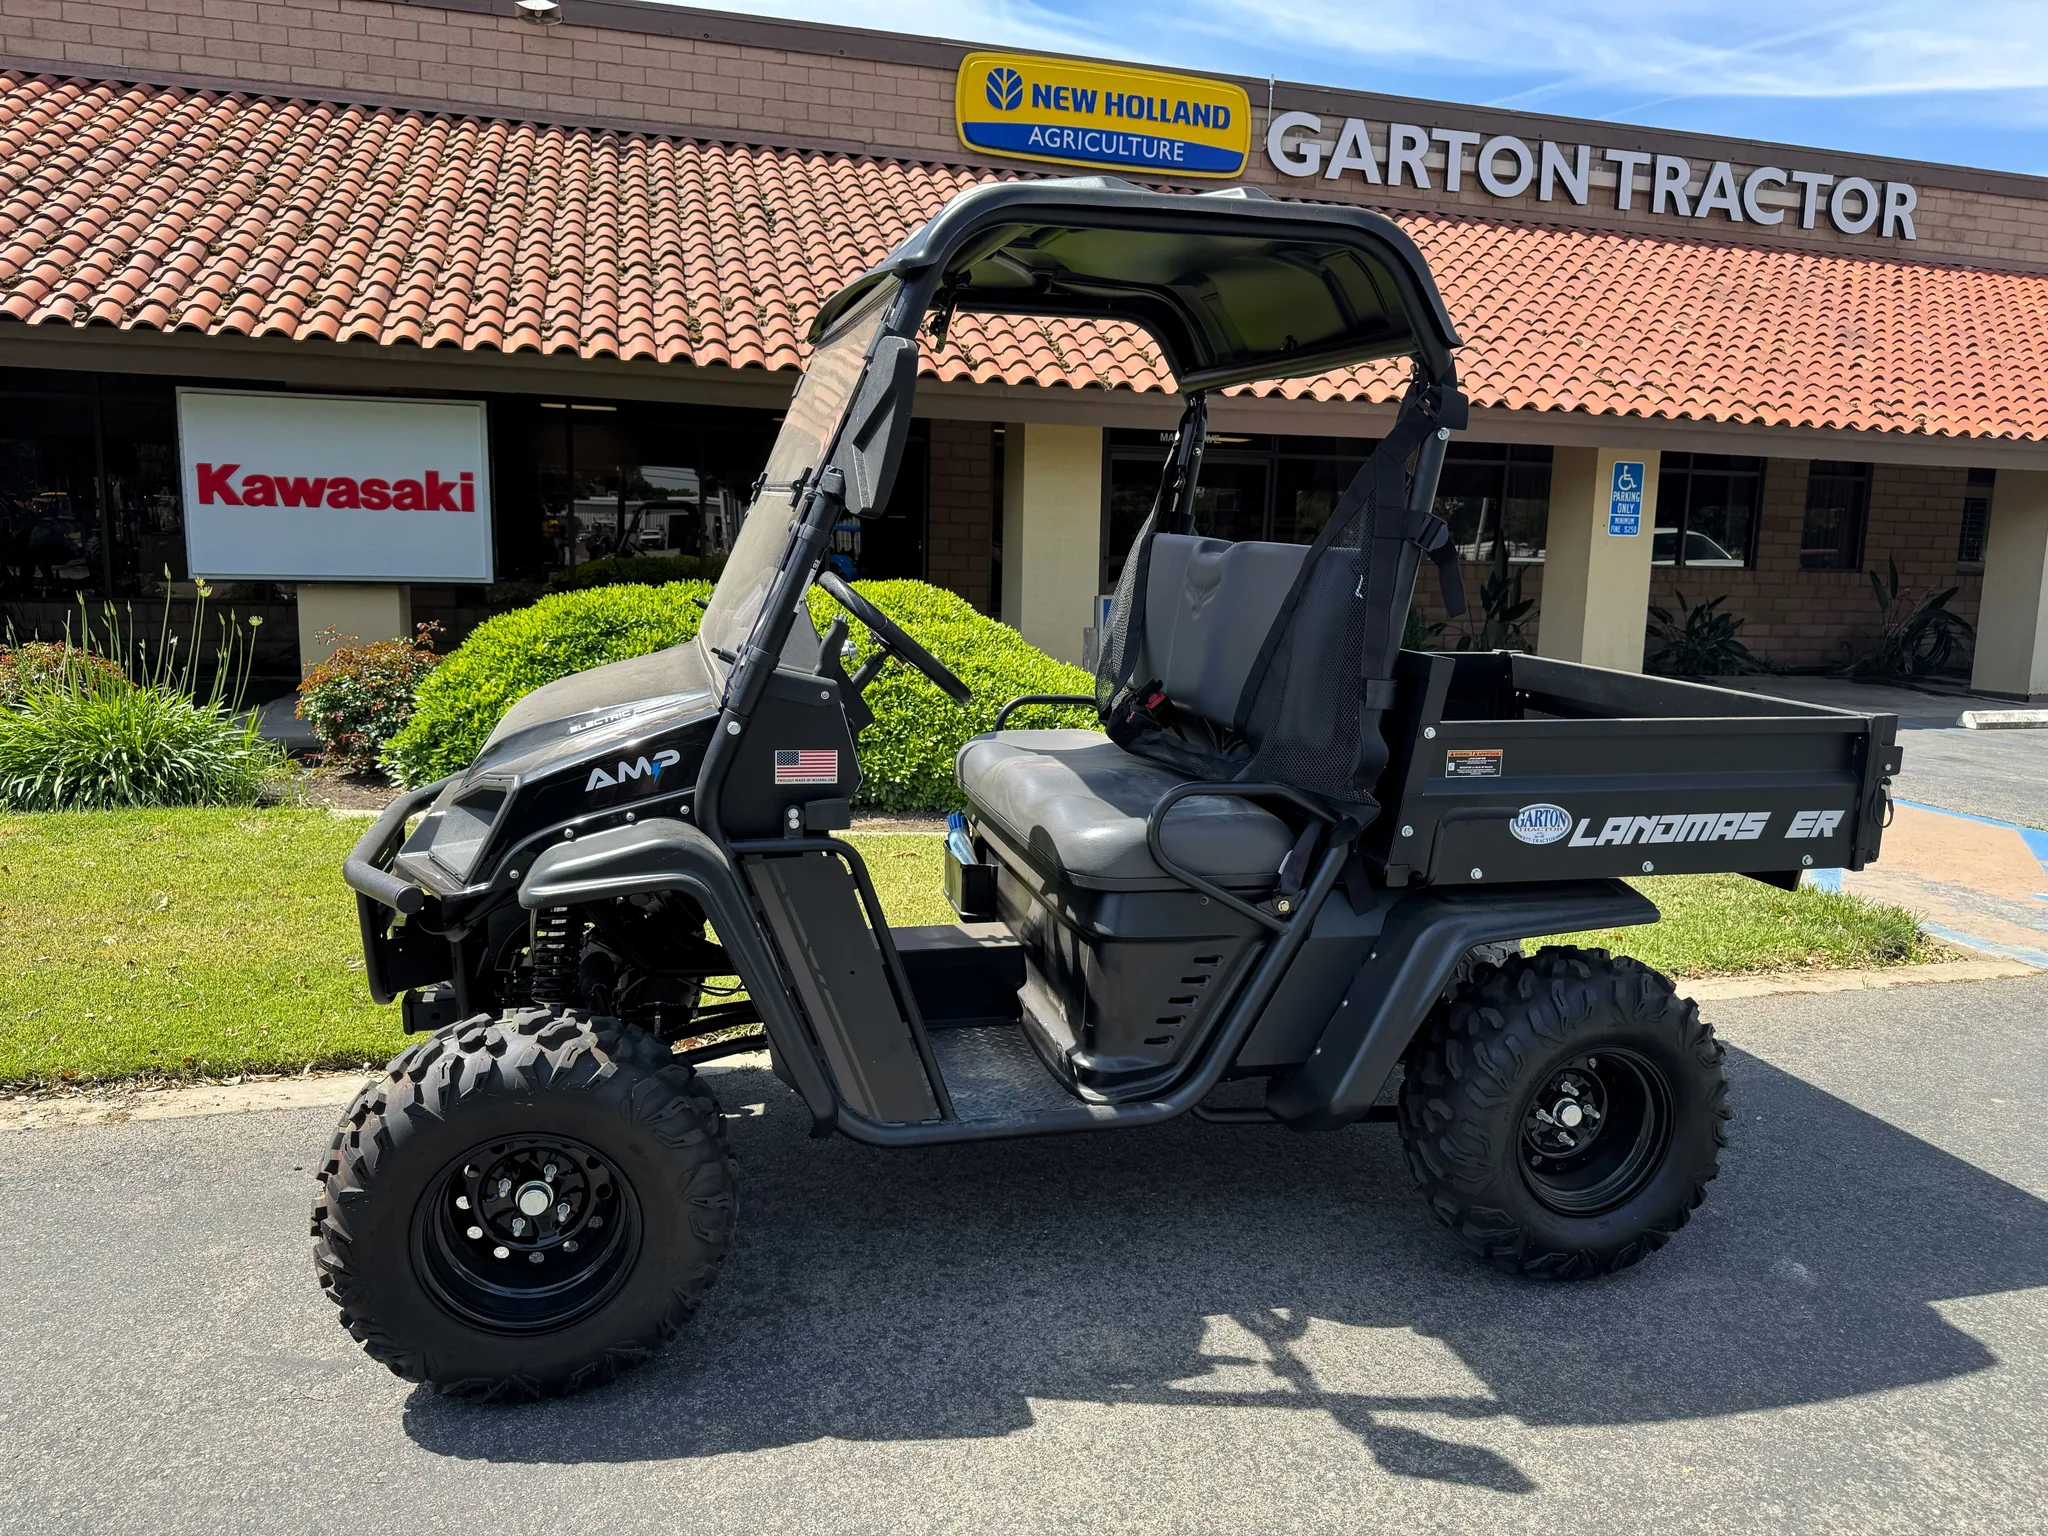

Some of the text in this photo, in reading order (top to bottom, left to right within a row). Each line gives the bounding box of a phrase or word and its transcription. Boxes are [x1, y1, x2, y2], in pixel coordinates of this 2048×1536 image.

[1032, 83, 1231, 130] NEW HOLLAND
[1028, 126, 1184, 161] AGRICULTURE
[1267, 111, 1917, 240] GARTON TRACTOR
[196, 463, 475, 512] Kawasaki
[1613, 491, 1640, 502] PARKING
[1617, 503, 1635, 514] ONLY
[568, 707, 635, 735] ELECTRIC
[585, 749, 681, 792] AMP
[1516, 810, 1566, 828] GARTON
